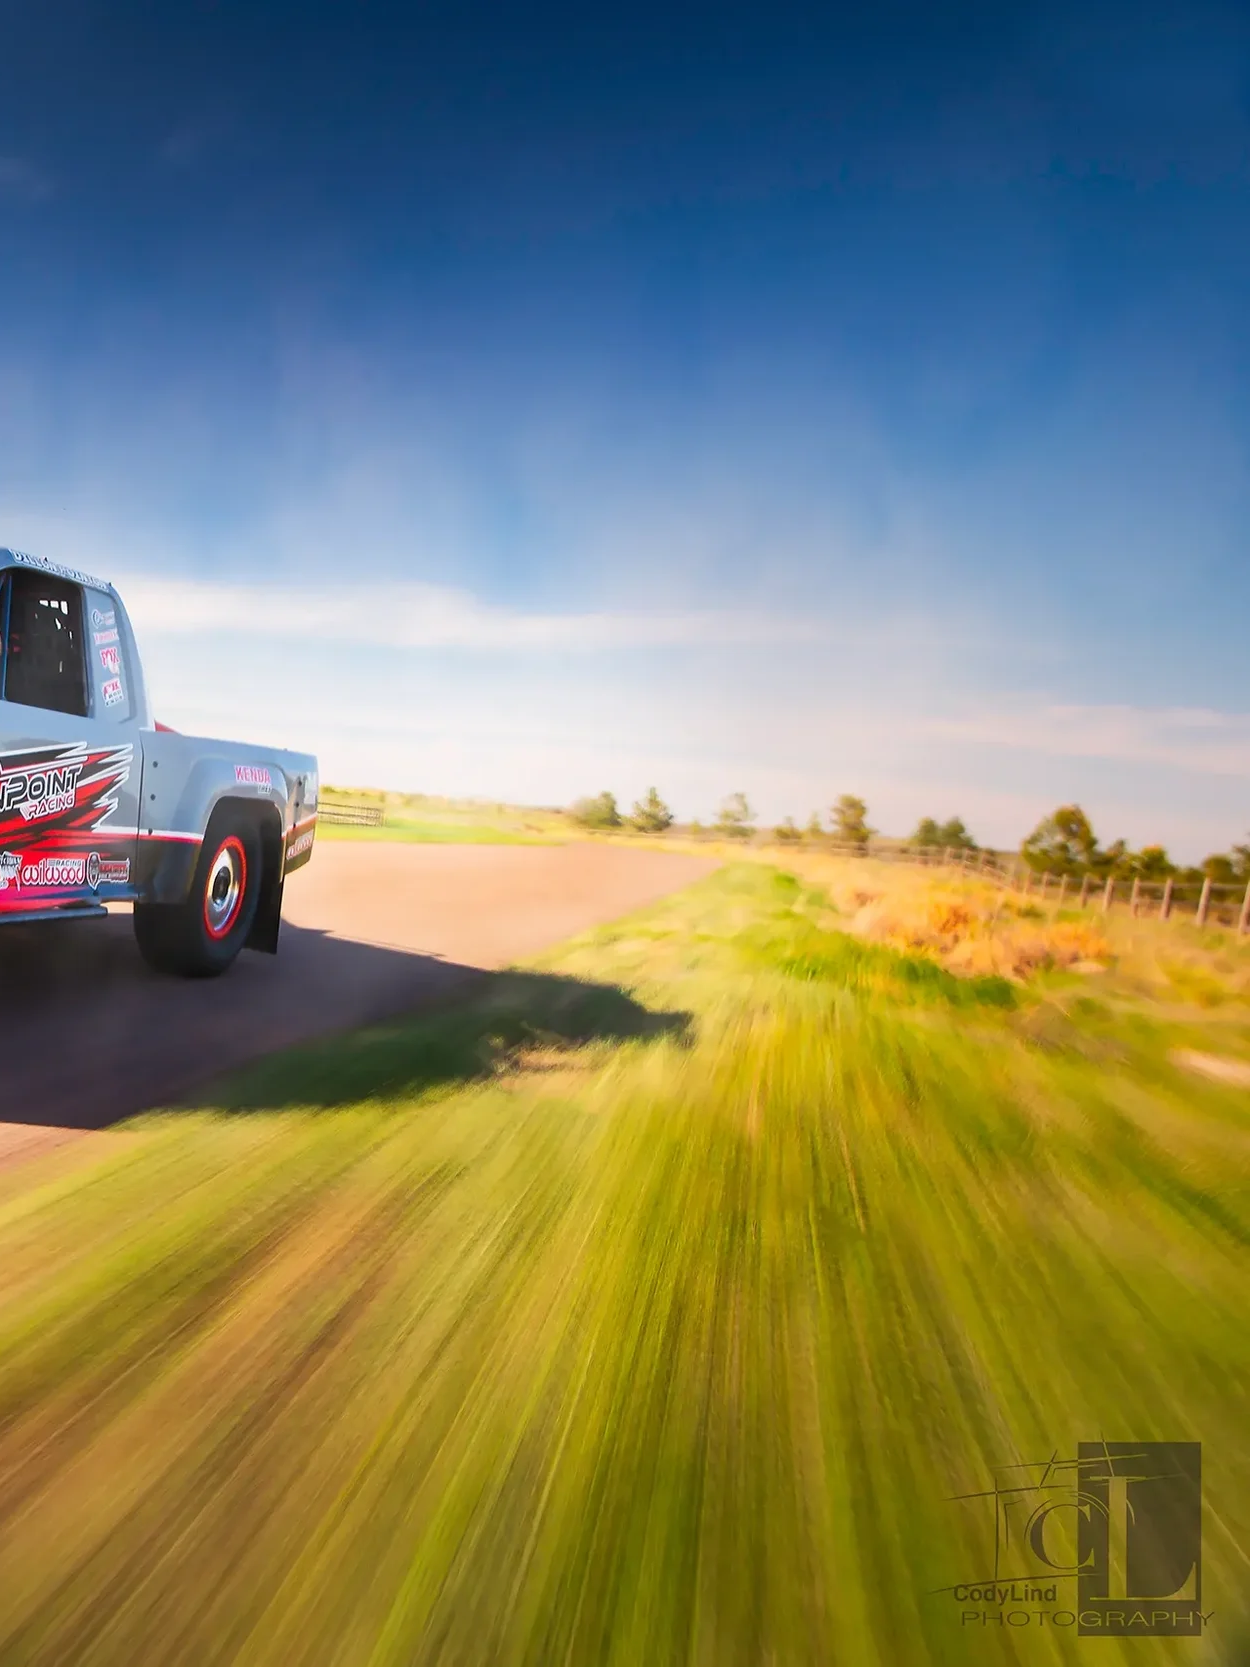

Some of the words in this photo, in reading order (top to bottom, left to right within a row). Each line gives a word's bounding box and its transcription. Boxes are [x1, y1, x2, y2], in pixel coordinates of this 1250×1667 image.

[234, 766, 271, 784] KENDA
[28, 792, 75, 818] RACING
[23, 858, 85, 884] wilwood
[56, 859, 82, 868] RACING
